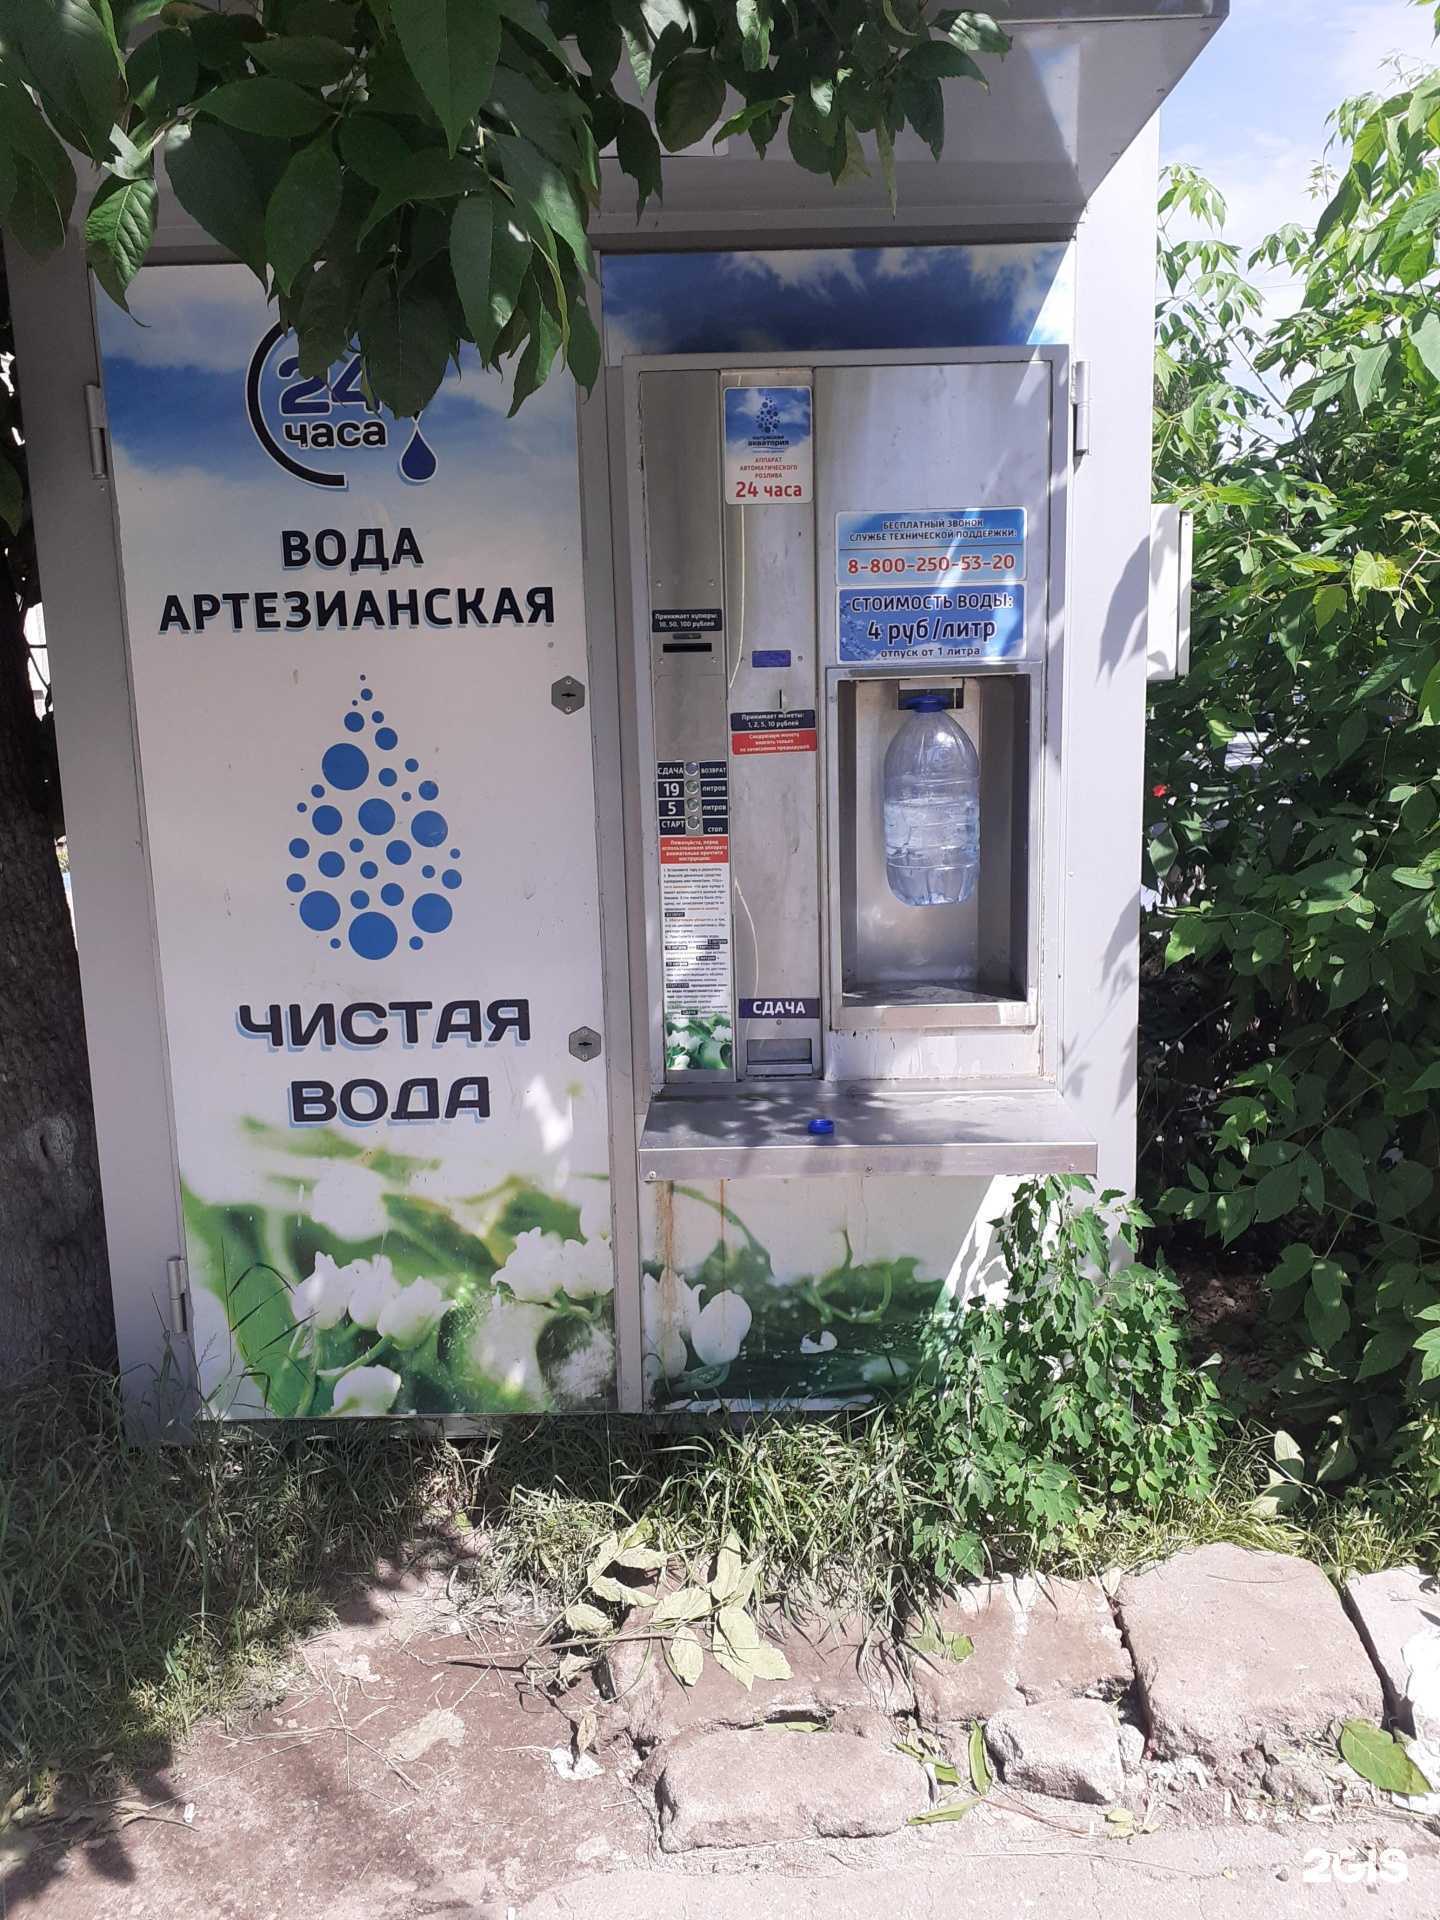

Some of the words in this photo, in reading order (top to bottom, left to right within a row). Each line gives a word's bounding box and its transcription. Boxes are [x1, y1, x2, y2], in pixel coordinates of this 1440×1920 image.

[284, 420, 388, 448] часа
[736, 481, 758, 497] 24
[764, 484, 802, 497] часа
[883, 519, 945, 530] БЕСПЛАТНЫЙ
[947, 518, 984, 528] ЗВОНОК
[849, 533, 887, 542] СЛУЖБЕ
[889, 530, 954, 541] ТЕХНИЧЕСКОЙ
[956, 528, 1017, 539] ПОДДЕРЖКИ:
[281, 528, 424, 575] ВОДА
[848, 554, 1015, 573] 8-800-250-53-20
[159, 586, 555, 634] АРТЕЗИАНСКАЯ
[852, 594, 953, 612] СТОИМОСТЬ
[957, 593, 1013, 610] ВОДЫ:
[868, 621, 881, 640] 4
[888, 618, 996, 644] руб/литр
[881, 648, 918, 659] отпуск
[921, 648, 934, 656] от
[938, 647, 943, 656] 1
[947, 647, 980, 657] литра
[657, 767, 683, 775] СДАЧА
[663, 783, 680, 796] 19
[667, 802, 677, 815] 5
[661, 820, 684, 828] СТАРТ
[752, 1001, 806, 1016] СДАЧА
[237, 999, 531, 1052] ЧИСТАЯ
[290, 1076, 491, 1124] ВОДА
